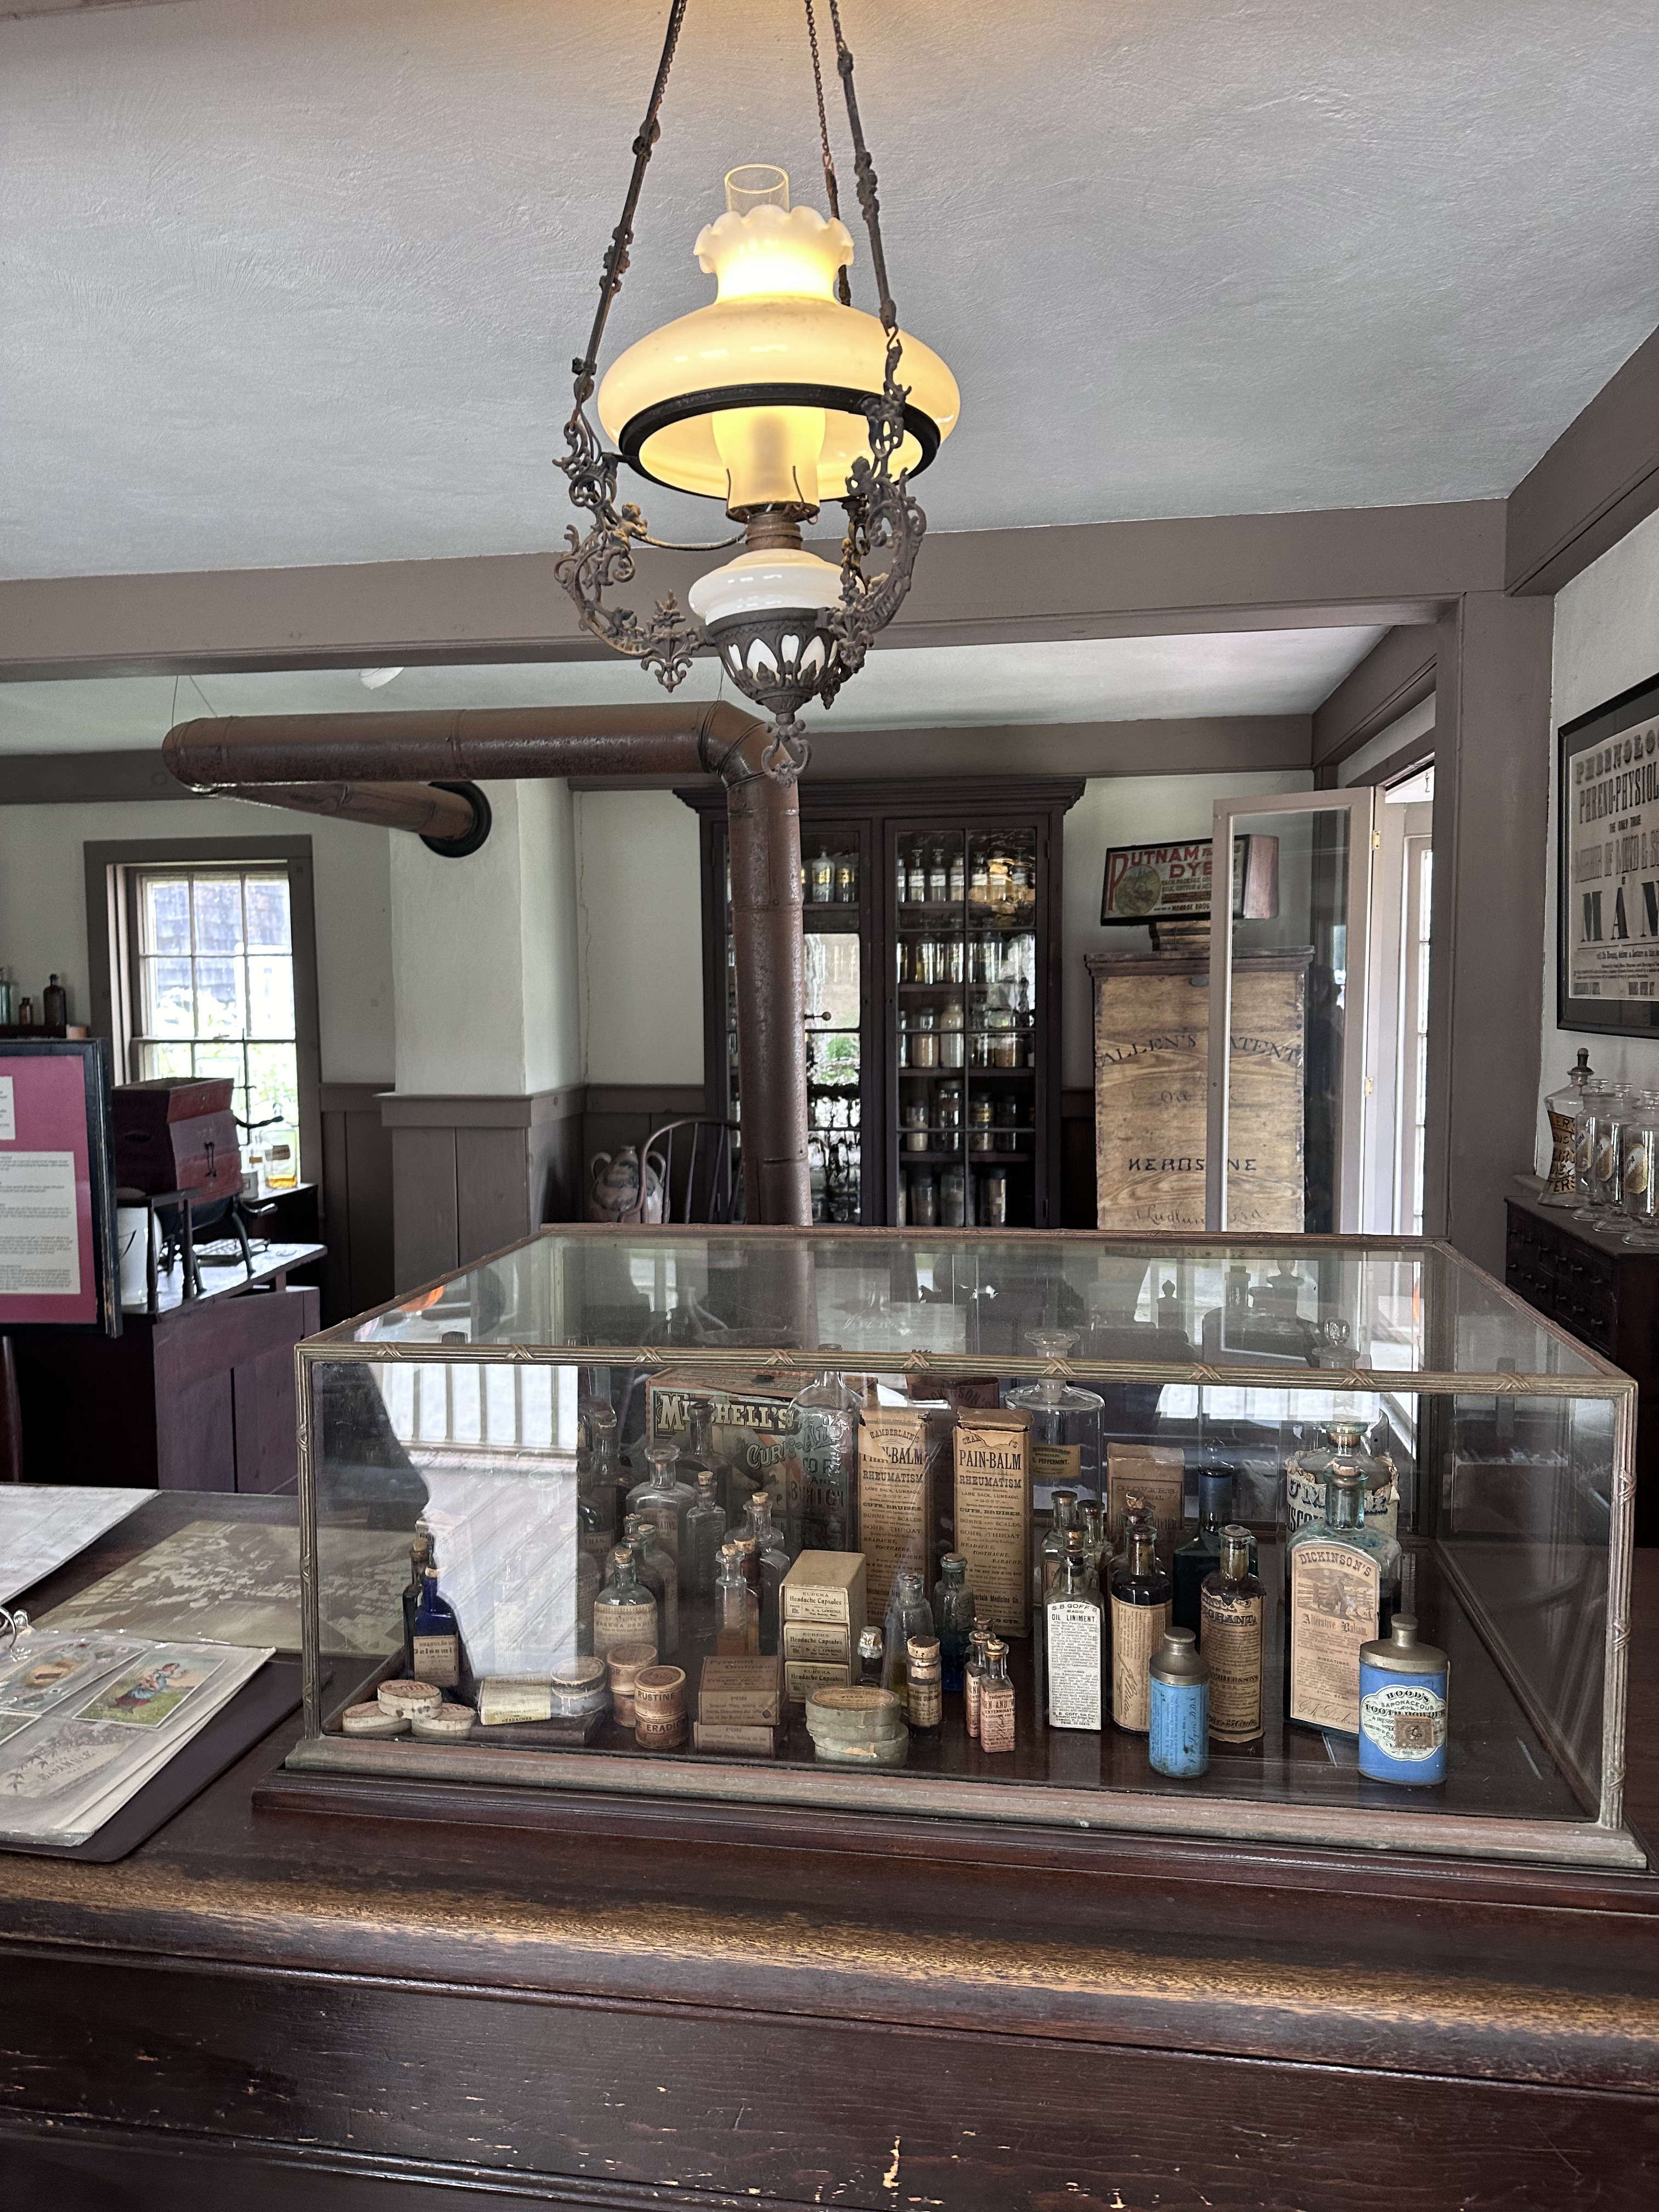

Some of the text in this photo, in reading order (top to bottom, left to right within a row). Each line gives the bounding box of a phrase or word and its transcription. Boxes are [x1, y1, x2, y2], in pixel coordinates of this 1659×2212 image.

[1576, 728, 1659, 785] PHRENOLO
[1108, 845, 1200, 911] PUTNAM
[1098, 1035, 1296, 1066] ALLEN'S ATENT
[1128, 1158, 1257, 1171] KEROSNE
[870, 1428, 920, 1443] HAMBERLAIN'S
[959, 1449, 1022, 1470] PAIN-BALM
[862, 1470, 923, 1483] RHEUMATISM
[959, 1475, 1022, 1489] RHEUMATISM
[1116, 1485, 1175, 1494] GLOVER'S
[1298, 1551, 1372, 1577] DICKINSON'S
[789, 1595, 842, 1606] Headache Capsules
[789, 1636, 843, 1646] Headache Capsules
[791, 1673, 844, 1683] Headache Capsules
[638, 1691, 675, 1701] RUSTINE
[1386, 1690, 1430, 1704] HOOD'S
[996, 1700, 1008, 1709] AND
[1381, 1700, 1435, 1711] SAPONACEOUS
[647, 1717, 684, 1732] ERADIC
